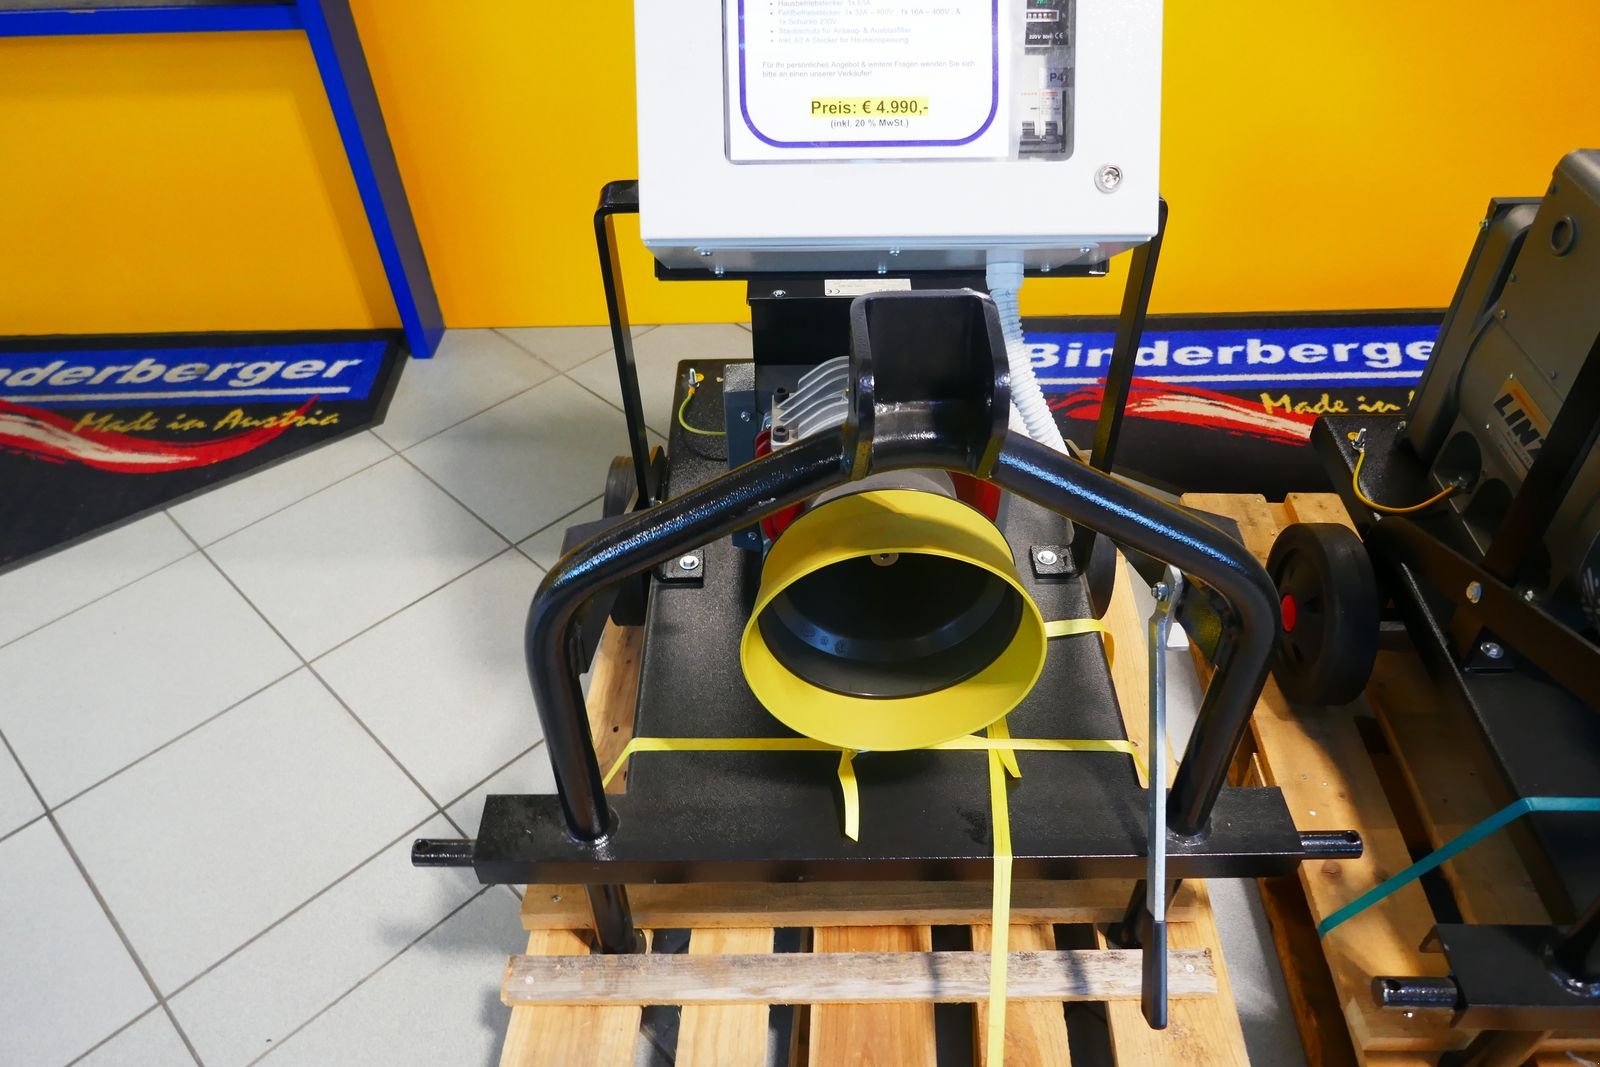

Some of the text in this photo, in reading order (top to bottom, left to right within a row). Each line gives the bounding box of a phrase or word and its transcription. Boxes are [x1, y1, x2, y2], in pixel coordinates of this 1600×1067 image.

[831, 61, 860, 69] Angebot
[811, 100, 929, 116] Preis: € 4.990,-
[830, 118, 910, 129] (inkl. 20 % MwSt.)
[1259, 391, 1345, 415] Made
[1356, 394, 1401, 413] in
[71, 407, 340, 434] Made in Austria
